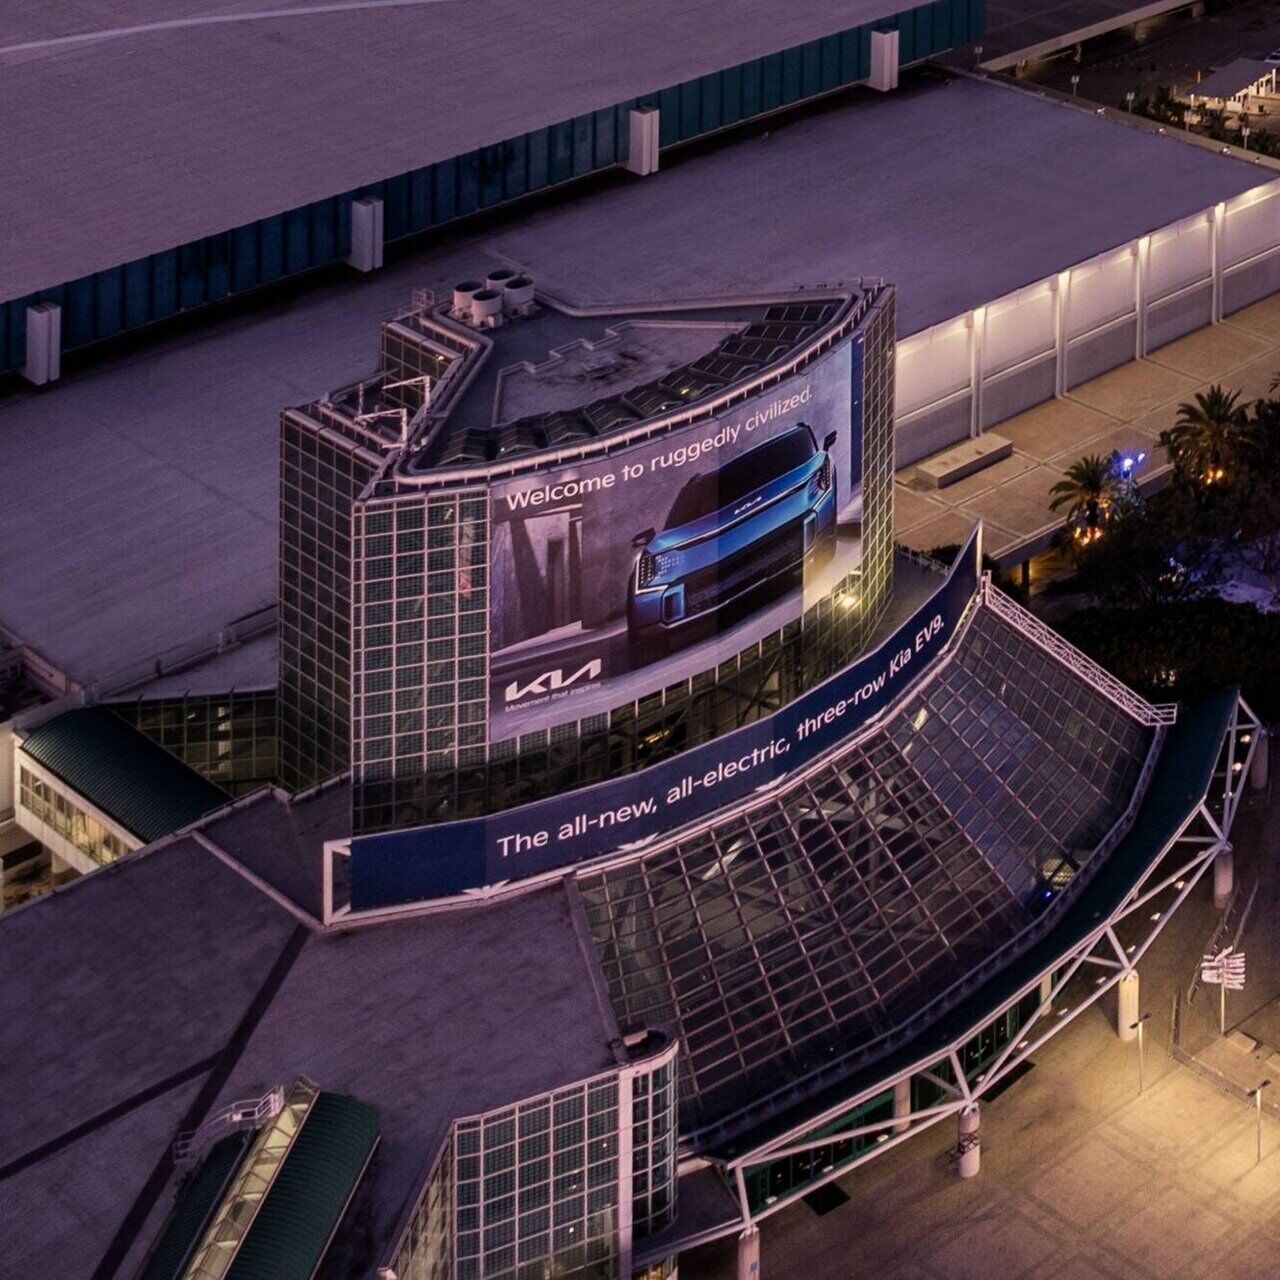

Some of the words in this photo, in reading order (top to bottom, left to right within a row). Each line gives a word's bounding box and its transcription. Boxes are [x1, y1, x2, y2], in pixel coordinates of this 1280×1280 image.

[506, 470, 616, 512] Welcome
[622, 461, 644, 482] to
[650, 423, 741, 473] ruggedly
[745, 384, 813, 431] civilized.
[497, 830, 549, 857] The
[557, 797, 658, 841] all-new,
[665, 737, 791, 805] all-electric,
[796, 673, 888, 741] three-row
[889, 648, 911, 678] Kia
[914, 614, 945, 654] EV9.
[504, 693, 551, 713] Movement
[551, 688, 569, 700] that
[570, 682, 601, 696] inspires
